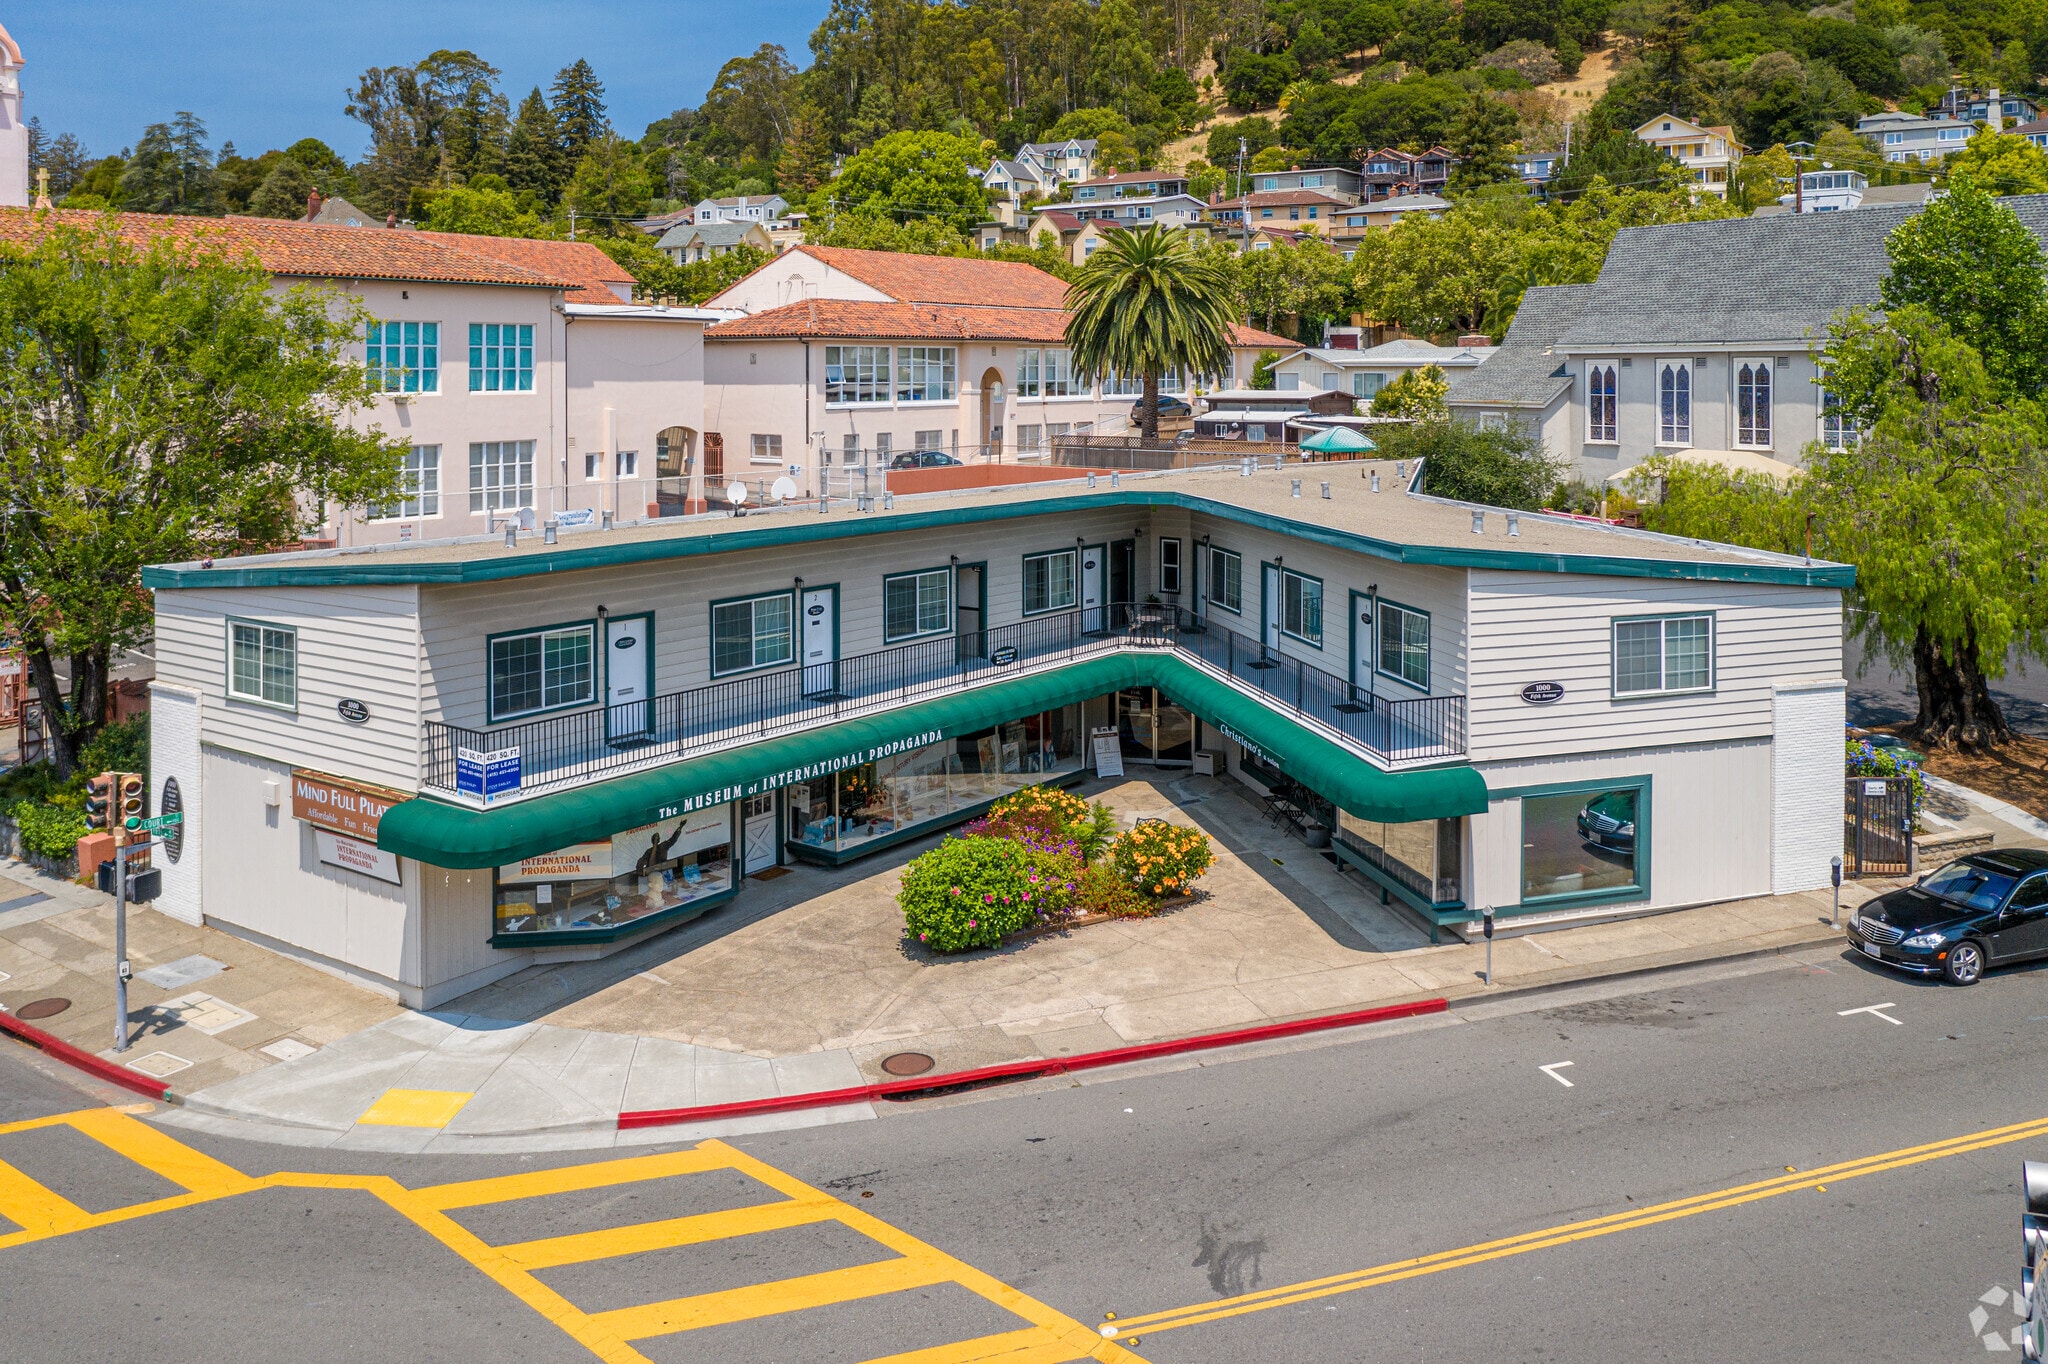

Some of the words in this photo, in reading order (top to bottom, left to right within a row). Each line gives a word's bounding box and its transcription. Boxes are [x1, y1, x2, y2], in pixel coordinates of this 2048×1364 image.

[1220, 724, 1262, 757] Christiano's
[486, 753, 497, 761] 420
[458, 759, 468, 767] FOR
[469, 763, 483, 771] LEASE
[486, 763, 499, 771] FOR
[500, 759, 519, 768] LEASE
[659, 807, 678, 819] The
[684, 785, 742, 812] MUSEUM
[748, 783, 758, 794] of
[763, 752, 864, 790] INTERNATIONAL
[869, 729, 942, 760] PROPAGANDA
[296, 781, 328, 803] MIND
[331, 790, 356, 812] FULL
[360, 797, 389, 817] PILAT
[494, 789, 520, 799] MERIDIAN
[144, 817, 163, 828] COURT
[308, 808, 338, 824] Affordable
[344, 817, 357, 829] Fun
[363, 822, 378, 834] Frie
[336, 844, 379, 863] INTERNATIONAL
[338, 852, 373, 870] PROPAGANDA
[521, 855, 592, 866] INTERNATIONAL
[521, 864, 580, 875] PROPAGANDA
